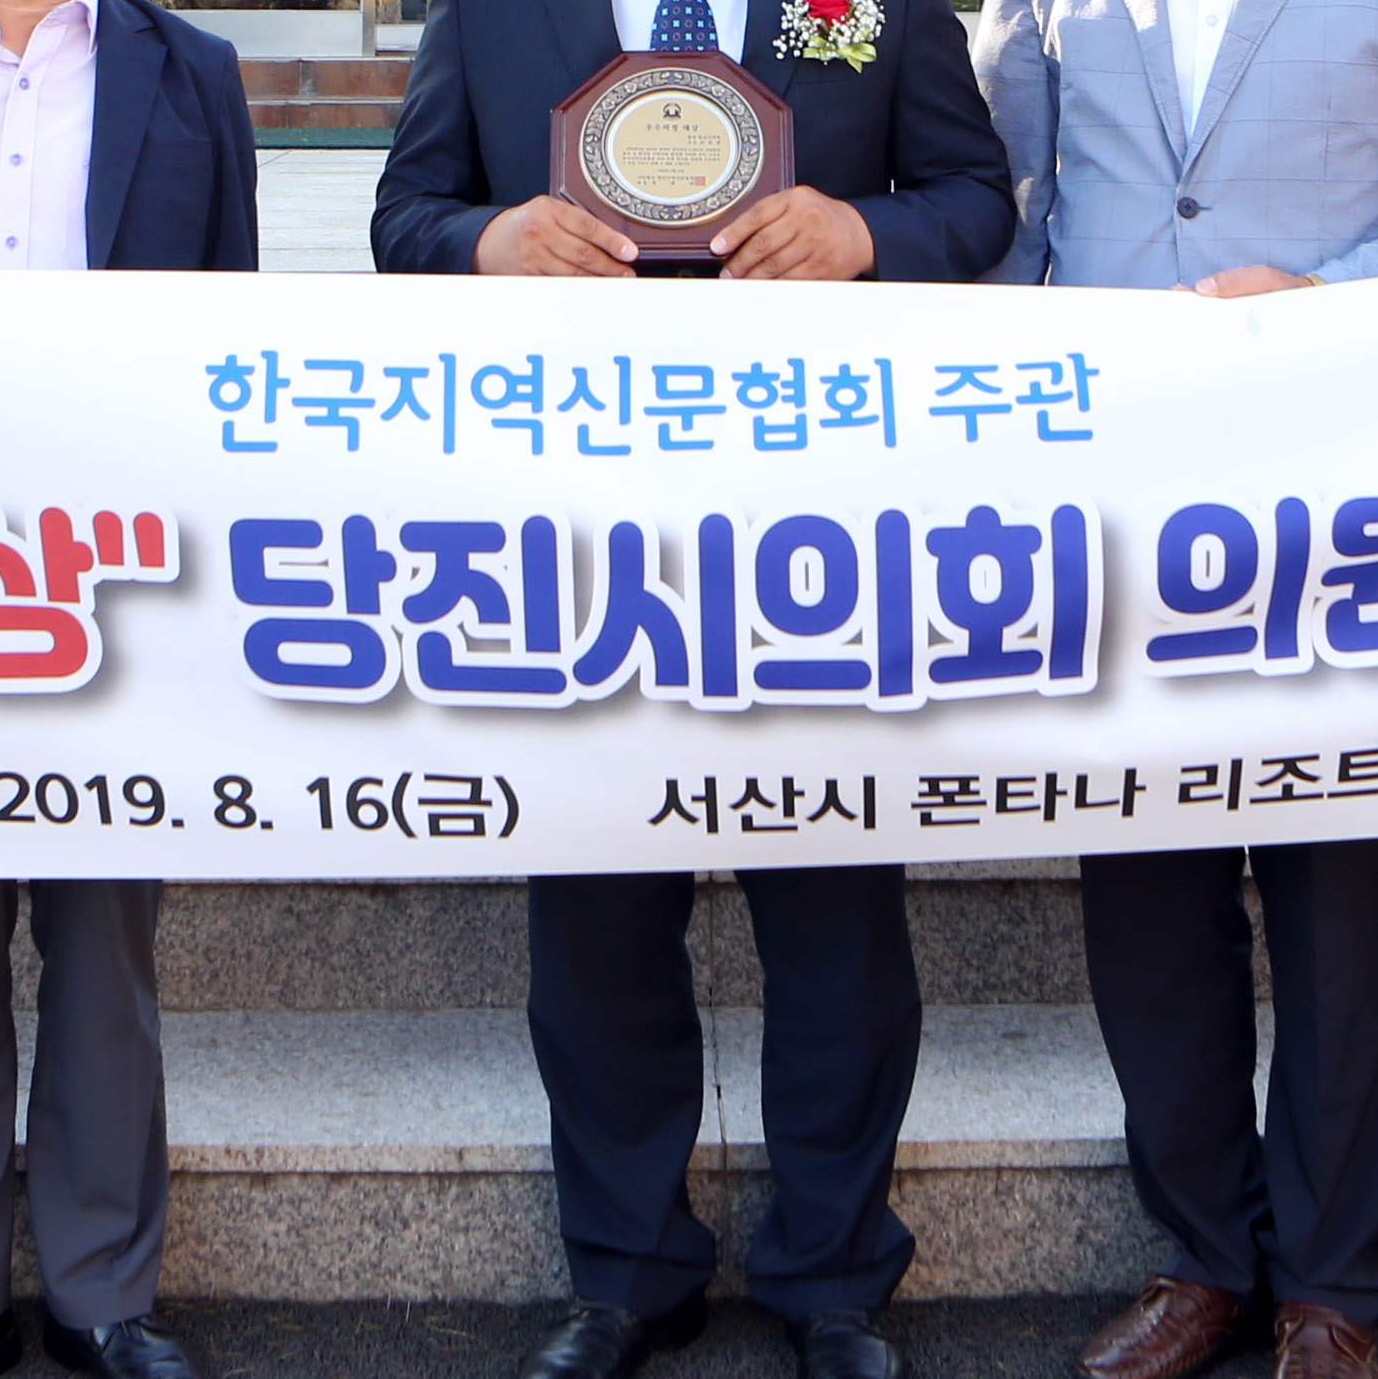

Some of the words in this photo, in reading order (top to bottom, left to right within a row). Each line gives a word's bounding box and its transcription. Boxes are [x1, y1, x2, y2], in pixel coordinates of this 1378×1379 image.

[205, 350, 898, 457] 한국지역신문협회
[929, 353, 1101, 443] 주관
[228, 503, 1090, 698] 당진시의회
[213, 774, 274, 830] 8.
[307, 772, 520, 839] 16(금)
[648, 775, 877, 835] 서산시
[911, 767, 1147, 827] 폰타나
